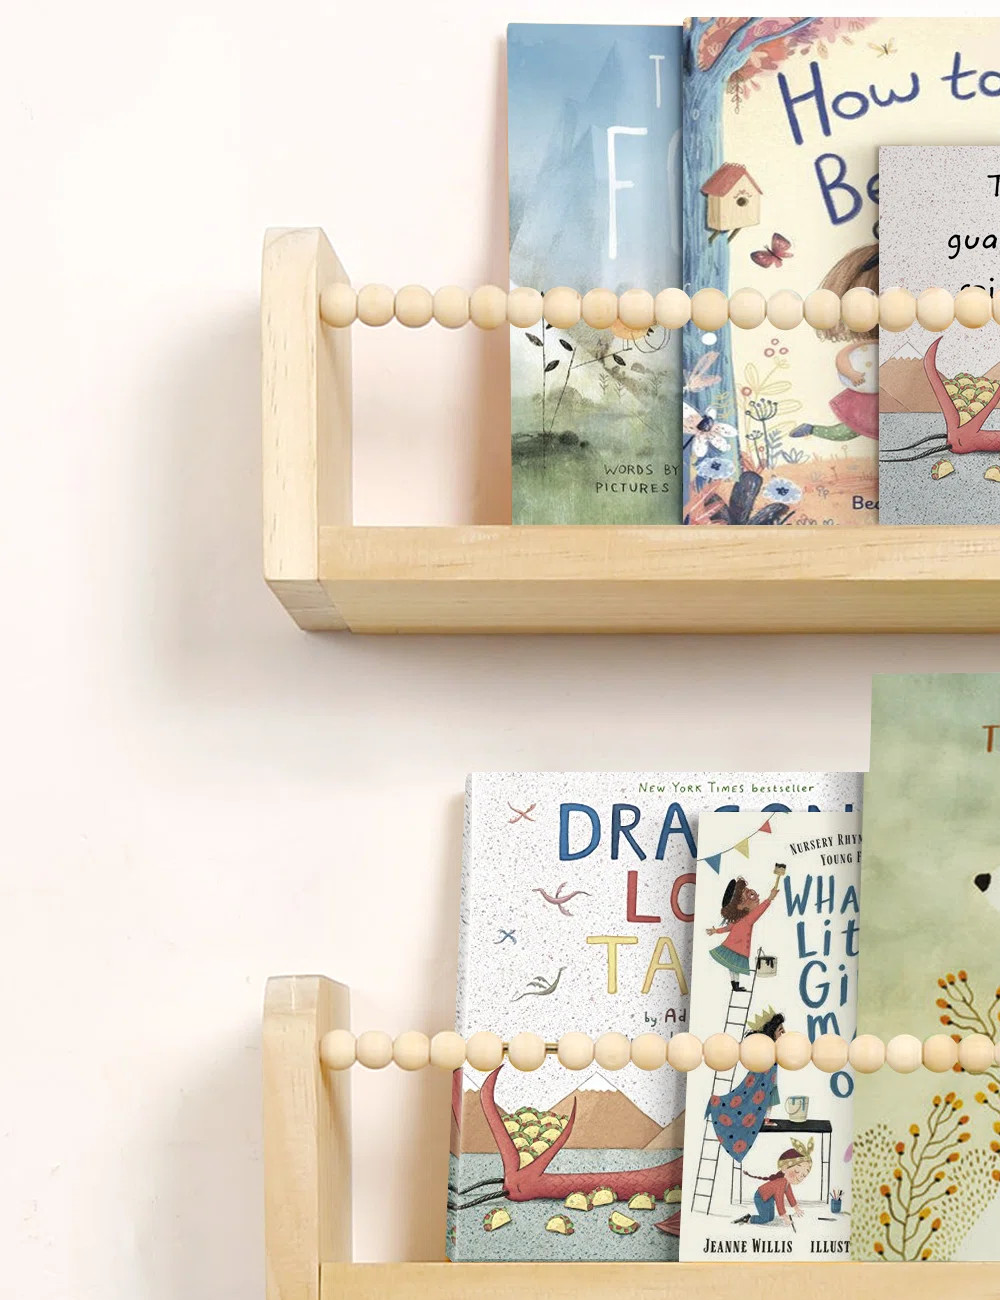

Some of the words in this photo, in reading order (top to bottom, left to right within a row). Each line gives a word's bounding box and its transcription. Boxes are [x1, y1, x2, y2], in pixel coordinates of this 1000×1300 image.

[777, 61, 920, 146] How
[603, 464, 653, 475] WORDS
[664, 465, 679, 476] BY
[595, 482, 670, 494] PICTURES
[638, 782, 666, 794] NEW
[671, 781, 702, 794] YORK
[707, 781, 744, 794] TIMES
[751, 783, 815, 794] bestseller
[789, 836, 833, 856] NURSERY
[820, 853, 853, 866] YOUNG
[586, 936, 689, 995] TA
[644, 1010, 657, 1027] by
[664, 1008, 687, 1024] Ad
[703, 1238, 748, 1254] JEANNE
[752, 1238, 793, 1254] WILLIS
[810, 1240, 850, 1254] ILLUST
